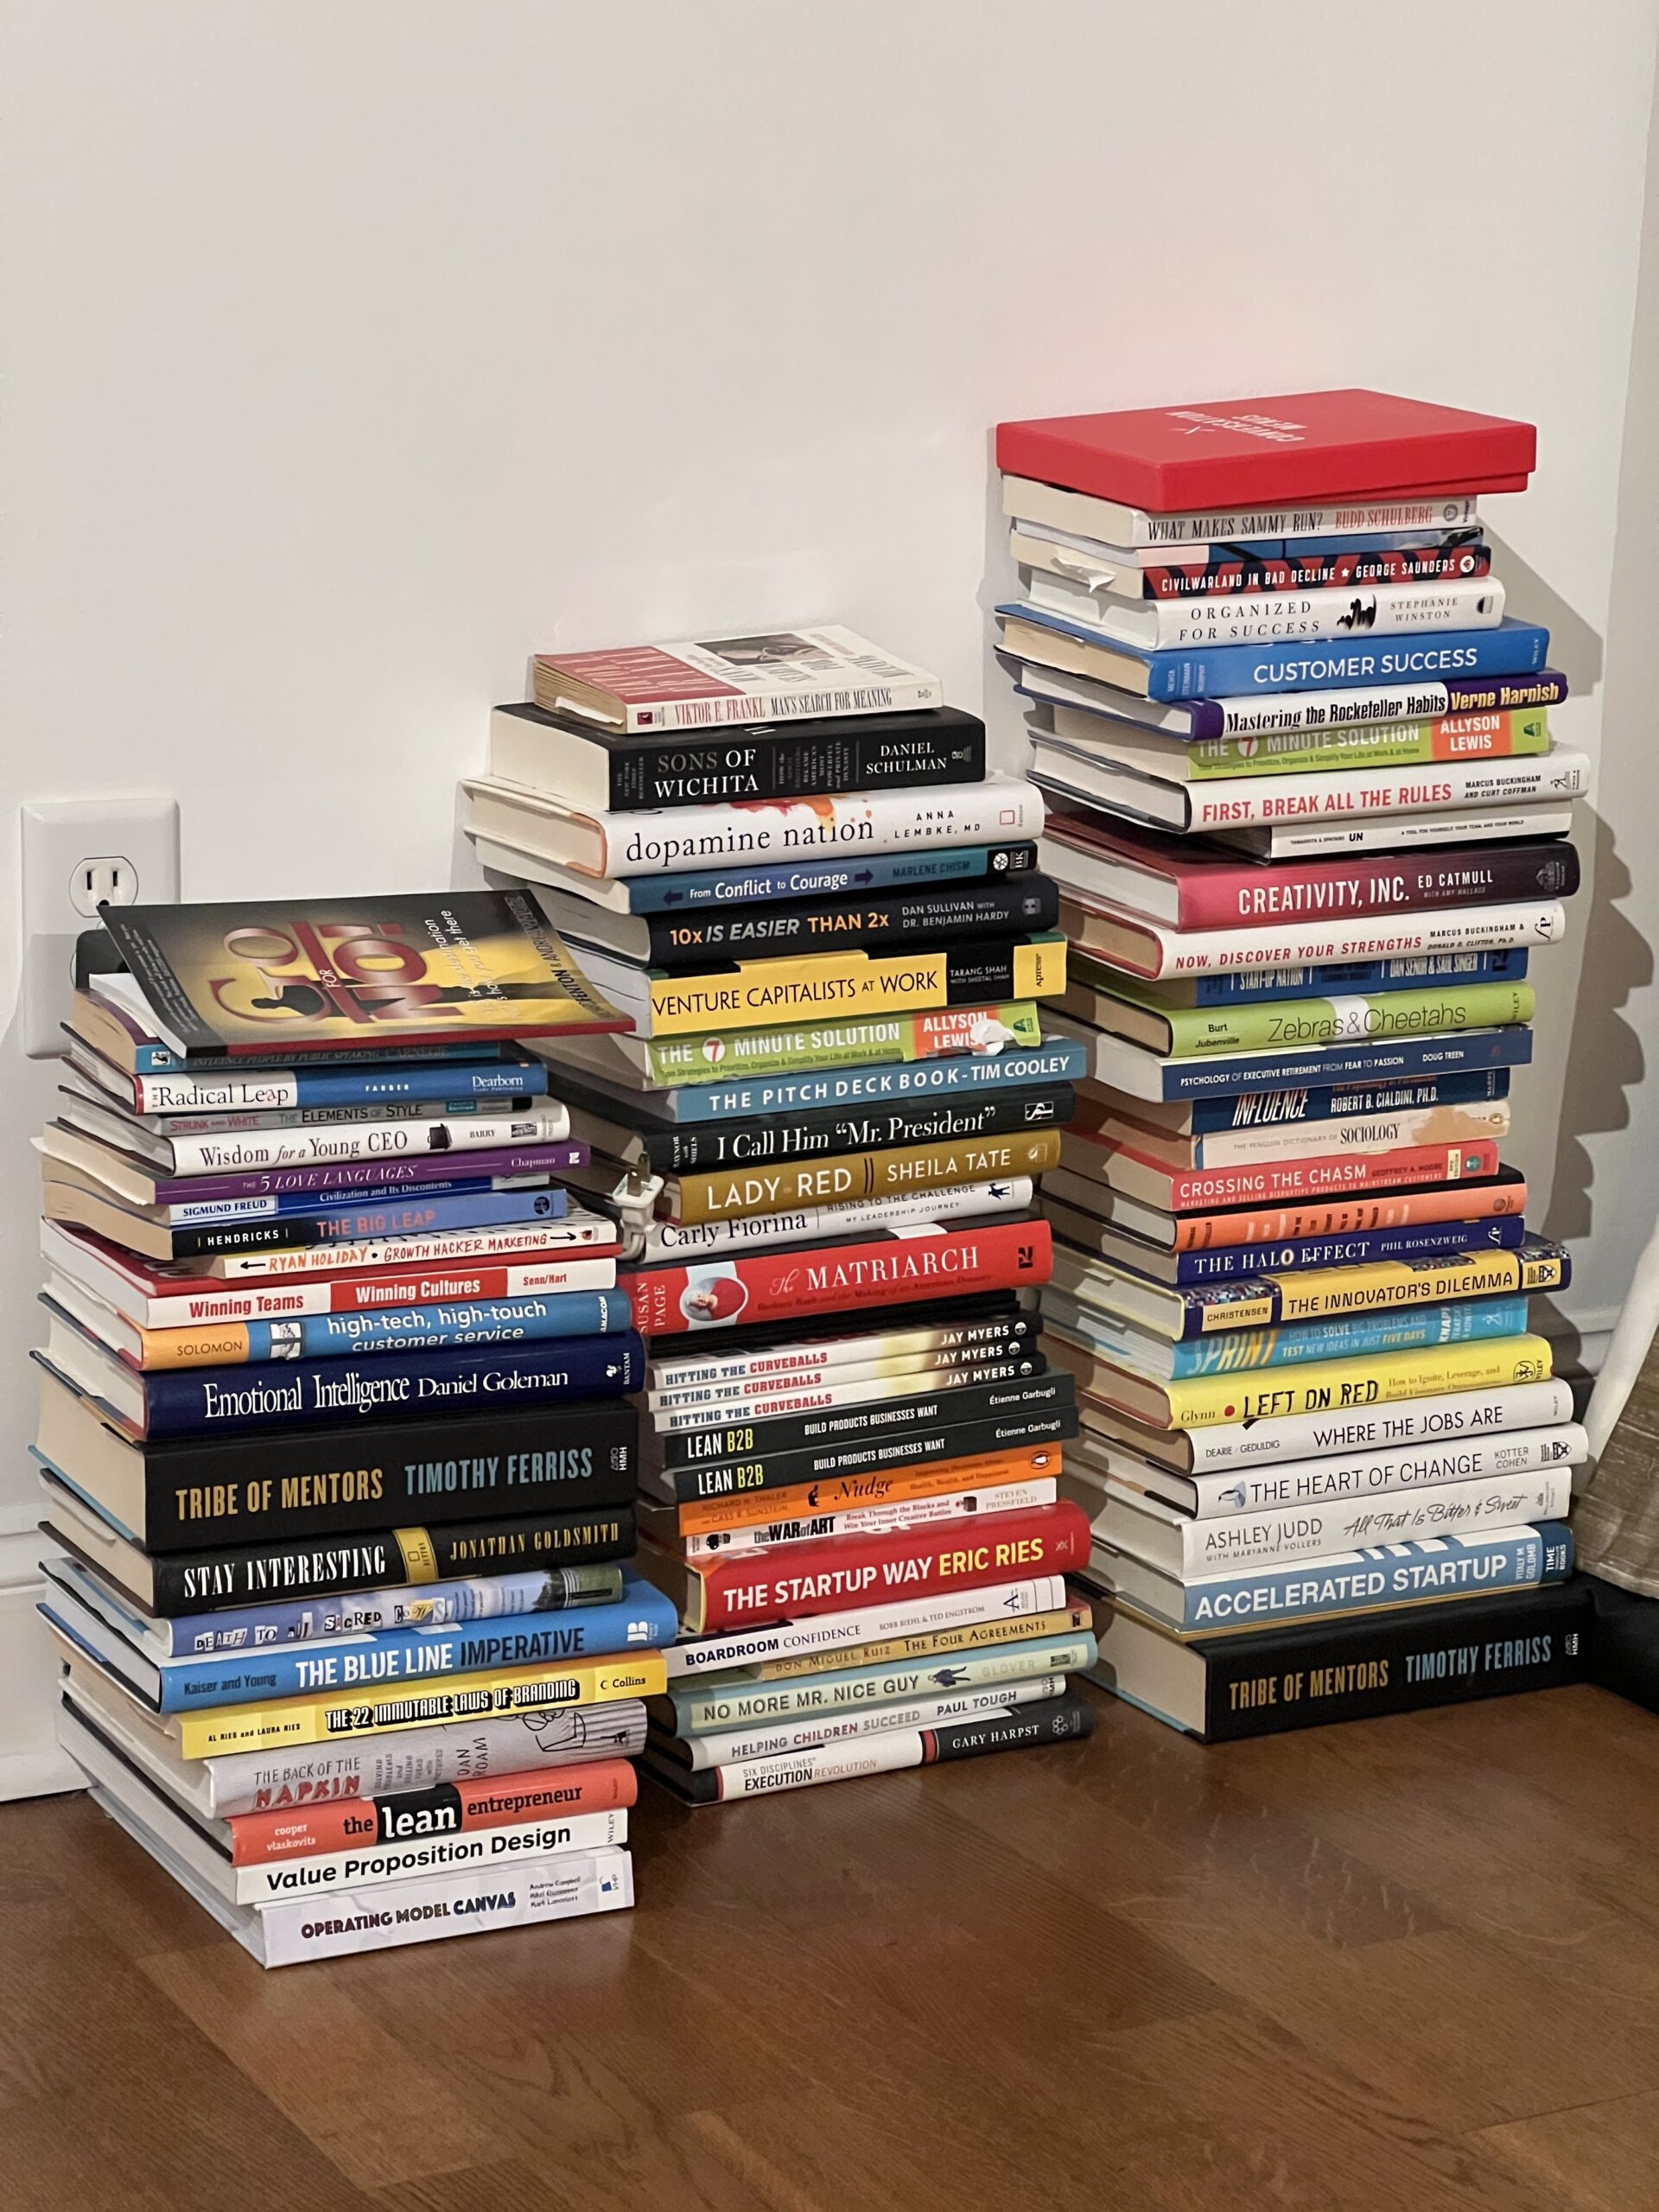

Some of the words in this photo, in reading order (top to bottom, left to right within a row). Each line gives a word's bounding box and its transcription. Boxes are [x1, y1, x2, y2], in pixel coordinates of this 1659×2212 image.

[1148, 521, 1185, 540] WHAT
[1192, 517, 1234, 538] MAKES
[1242, 514, 1287, 534] SAMMY
[1294, 512, 1323, 531] RUN?
[1162, 573, 1242, 591] CIVILWARLAND
[1248, 572, 1258, 586] IN
[1265, 570, 1285, 584] BAD
[1291, 568, 1335, 582] DECLINE
[1356, 563, 1395, 577] GEORGE
[1402, 559, 1455, 574] SAUNDERS
[1191, 601, 1311, 620] ORGANIZED
[1391, 598, 1458, 610] STEPHANIE
[1395, 610, 1451, 621] WINSTON
[1179, 628, 1217, 641] FOR
[1230, 621, 1319, 638] SUCCESS
[1254, 657, 1375, 683] CUSTOMER
[1381, 648, 1477, 672] SUCCESS
[1451, 692, 1496, 710] Verne
[1501, 683, 1559, 705] Harnish
[658, 752, 717, 773] SONS
[726, 749, 756, 767] OF
[654, 775, 760, 798] WICHITA
[1465, 779, 1494, 788] MARCUS
[1497, 775, 1541, 785] BUCKINGHAM
[1503, 786, 1536, 796] COFFMAN
[1203, 801, 1255, 822] FIRST,
[1262, 796, 1319, 817] BREAK
[1325, 793, 1354, 811] ALL
[1361, 789, 1391, 807] THE
[1399, 784, 1452, 804] RULES
[916, 810, 954, 821] ANNA
[626, 827, 771, 867] dopamine
[783, 817, 874, 847] nation
[895, 826, 957, 838] LEMBKE,
[690, 889, 711, 899] From
[715, 880, 772, 899] Conflict
[791, 874, 848, 890] Courage
[1418, 875, 1433, 888] ED
[1439, 870, 1493, 887] CATMULL
[1238, 880, 1363, 914] CREATIVITY,
[1370, 876, 1409, 904] INC.
[950, 969, 982, 977] TARANG
[985, 965, 1007, 974] SHAH
[652, 990, 740, 1015] VENTURE
[747, 979, 855, 1007] CAPITALISTS
[861, 981, 874, 991] AT
[880, 971, 938, 993] WORK
[159, 1084, 233, 1106] Radical
[242, 1084, 289, 1107] Leap
[709, 1092, 751, 1111] THE
[764, 1083, 827, 1104] PITCH
[836, 1077, 892, 1096] DECK
[899, 1069, 958, 1090] BOOK
[971, 1065, 1001, 1081] TIM
[1004, 1057, 1070, 1077] COOLEY
[200, 1145, 269, 1166] Wisdom
[273, 1146, 296, 1165] for
[298, 1148, 306, 1158] a
[309, 1138, 359, 1157] Young
[368, 1131, 407, 1151] CEO
[887, 1157, 957, 1182] SHEILA
[966, 1149, 1011, 1170] TATE
[708, 1177, 780, 1210] LADY
[798, 1169, 851, 1197] RED
[1180, 1175, 1265, 1198] CROSSING
[1272, 1172, 1302, 1188] THE
[1309, 1165, 1366, 1183] CHASM
[183, 1205, 231, 1217] SIGMUND
[234, 1200, 267, 1210] FREUD
[861, 1208, 916, 1222] LEADERSHIP
[919, 1203, 960, 1212] JOURNEY
[207, 1230, 279, 1246] HENDRICKS
[385, 1246, 429, 1261] GROWTH
[434, 1240, 483, 1253] HACKER
[488, 1234, 547, 1250] MARKETING
[356, 1284, 416, 1303] Winning
[421, 1279, 480, 1298] Cultures
[524, 1274, 567, 1286] Senn/Hart
[1289, 1297, 1319, 1314] THE
[1325, 1282, 1431, 1309] INNOVATOR'S
[1436, 1272, 1512, 1294] DILEMMA
[1207, 1306, 1268, 1322] CHRISTENSEN
[178, 1341, 242, 1356] SOLOMON
[204, 1376, 302, 1418] Emotional
[313, 1372, 410, 1413] Intelligence
[989, 1394, 1020, 1405] Étienne
[1022, 1388, 1056, 1400] Garbugli
[1243, 1391, 1295, 1418] LEFT
[1306, 1388, 1331, 1409] ON
[1340, 1380, 1379, 1406] RED
[1313, 1423, 1376, 1447] WHERE
[1382, 1419, 1414, 1439] THE
[1421, 1412, 1463, 1434] JOBS
[1471, 1407, 1503, 1426] ARE
[688, 1433, 721, 1459] LEAN
[727, 1428, 753, 1452] B2B
[1495, 1447, 1529, 1459] KOTTER
[1497, 1459, 1528, 1469] COHEN
[176, 1484, 238, 1521] TRIBE
[247, 1480, 272, 1512] OF
[282, 1468, 383, 1508] MENTORS
[405, 1457, 499, 1495] TIMOTHY
[508, 1448, 593, 1484] FERRISS
[450, 1535, 525, 1560] JONATHAN
[534, 1522, 619, 1550] GOLDSMITH
[723, 1584, 767, 1611] THE
[775, 1564, 877, 1605] STARTUP
[883, 1557, 933, 1586] WAY
[939, 1548, 988, 1576] ERIC
[995, 1538, 1044, 1567] RIES
[1195, 1573, 1385, 1620] ACCELERATED
[1393, 1555, 1507, 1592] STARTUP
[296, 1659, 337, 1687] THE
[344, 1650, 398, 1681] BLUE
[405, 1643, 453, 1675] LINE
[461, 1627, 584, 1666] IMPERATIVE
[184, 1682, 218, 1694] Kaiser
[221, 1678, 240, 1690] and
[245, 1675, 276, 1687] Young
[613, 1676, 646, 1688] Collins
[1230, 1677, 1277, 1711] TRIBE
[1284, 1673, 1305, 1700] OF
[1310, 1660, 1389, 1697] MENTORS
[1406, 1646, 1478, 1682] TIMOTHY
[1485, 1636, 1551, 1670] FERRISS
[704, 1706, 730, 1720] NO
[739, 1695, 789, 1716] MORE
[798, 1691, 828, 1707] MR.
[834, 1683, 875, 1700] NICE
[883, 1675, 919, 1694] GUY
[938, 1700, 968, 1716] PAUL
[974, 1691, 1016, 1708] TOUGH
[257, 1726, 280, 1736] LAURA
[284, 1723, 301, 1732] RIES
[953, 1733, 986, 1749] GARY
[991, 1725, 1039, 1743] HARPST
[344, 1816, 373, 1834] the
[382, 1805, 457, 1839] lean
[467, 1787, 582, 1815] entrepreneur
[275, 1824, 308, 1837] cooper
[267, 1837, 315, 1852] vlaskovits
[267, 1866, 336, 1891] Value
[345, 1842, 483, 1878] Proposition
[491, 1827, 570, 1853] Design
[302, 1912, 392, 1939] OPERATING
[396, 1903, 450, 1923] MODEL
[454, 1892, 516, 1916] CANVAS
